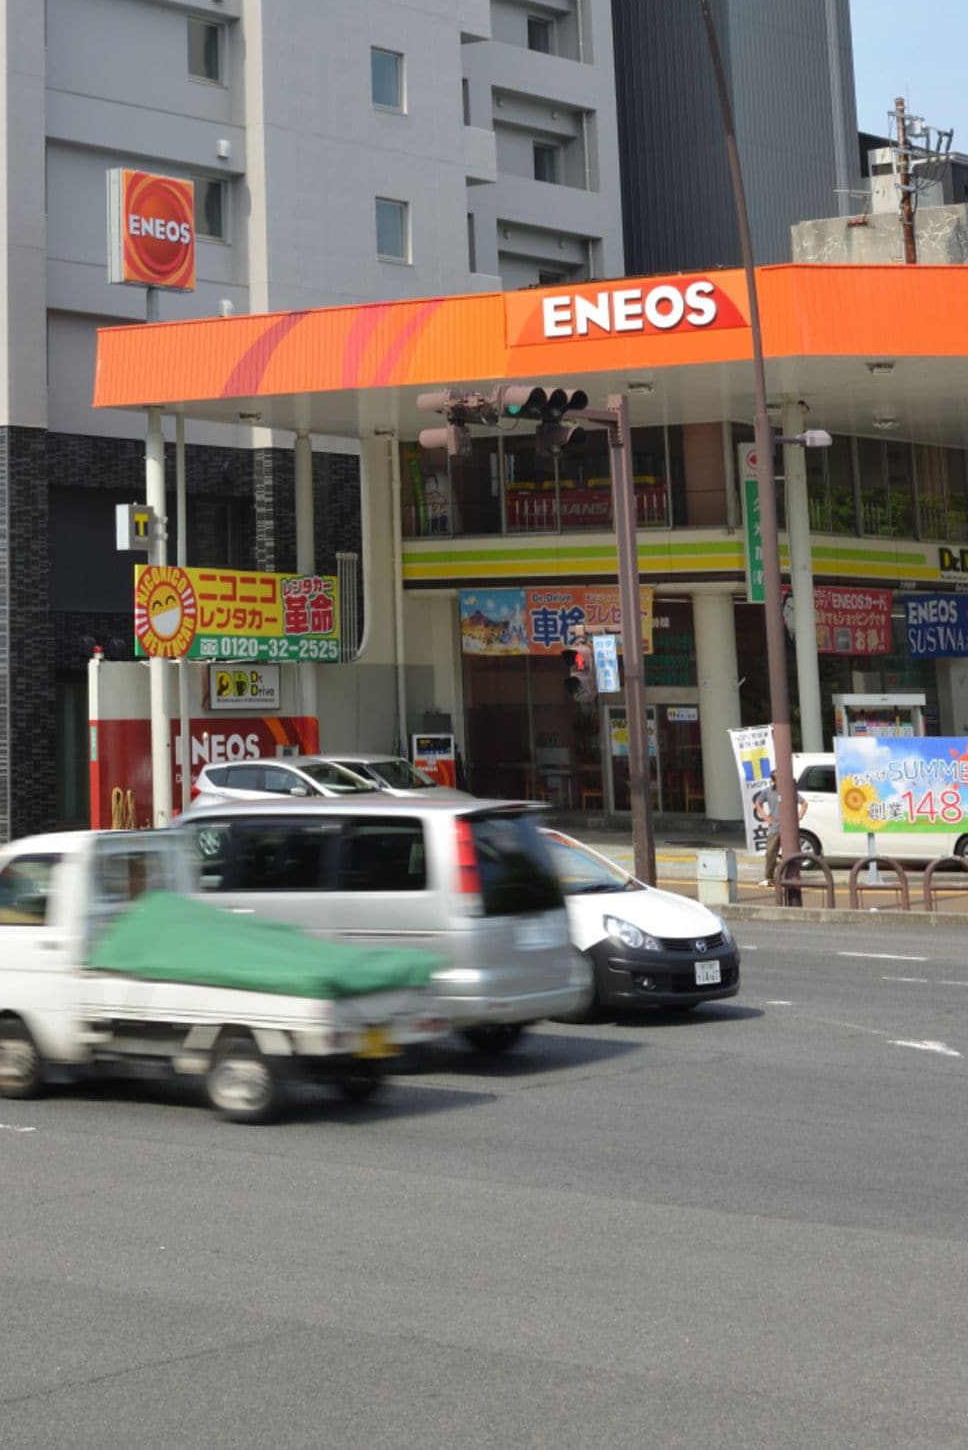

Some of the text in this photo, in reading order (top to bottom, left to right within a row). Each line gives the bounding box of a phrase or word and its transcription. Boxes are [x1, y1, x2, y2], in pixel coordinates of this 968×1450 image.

[129, 214, 191, 245] ENEOS
[542, 281, 717, 337] ENEOS
[199, 573, 277, 605] ニコニコ
[283, 575, 333, 596] レンタカー
[200, 606, 278, 631] レンタカー
[284, 594, 335, 636] 革命
[531, 606, 586, 647] 車検
[907, 600, 958, 625] ENEOS
[221, 637, 338, 659] 0120-32-2525
[250, 684, 275, 697] Drive
